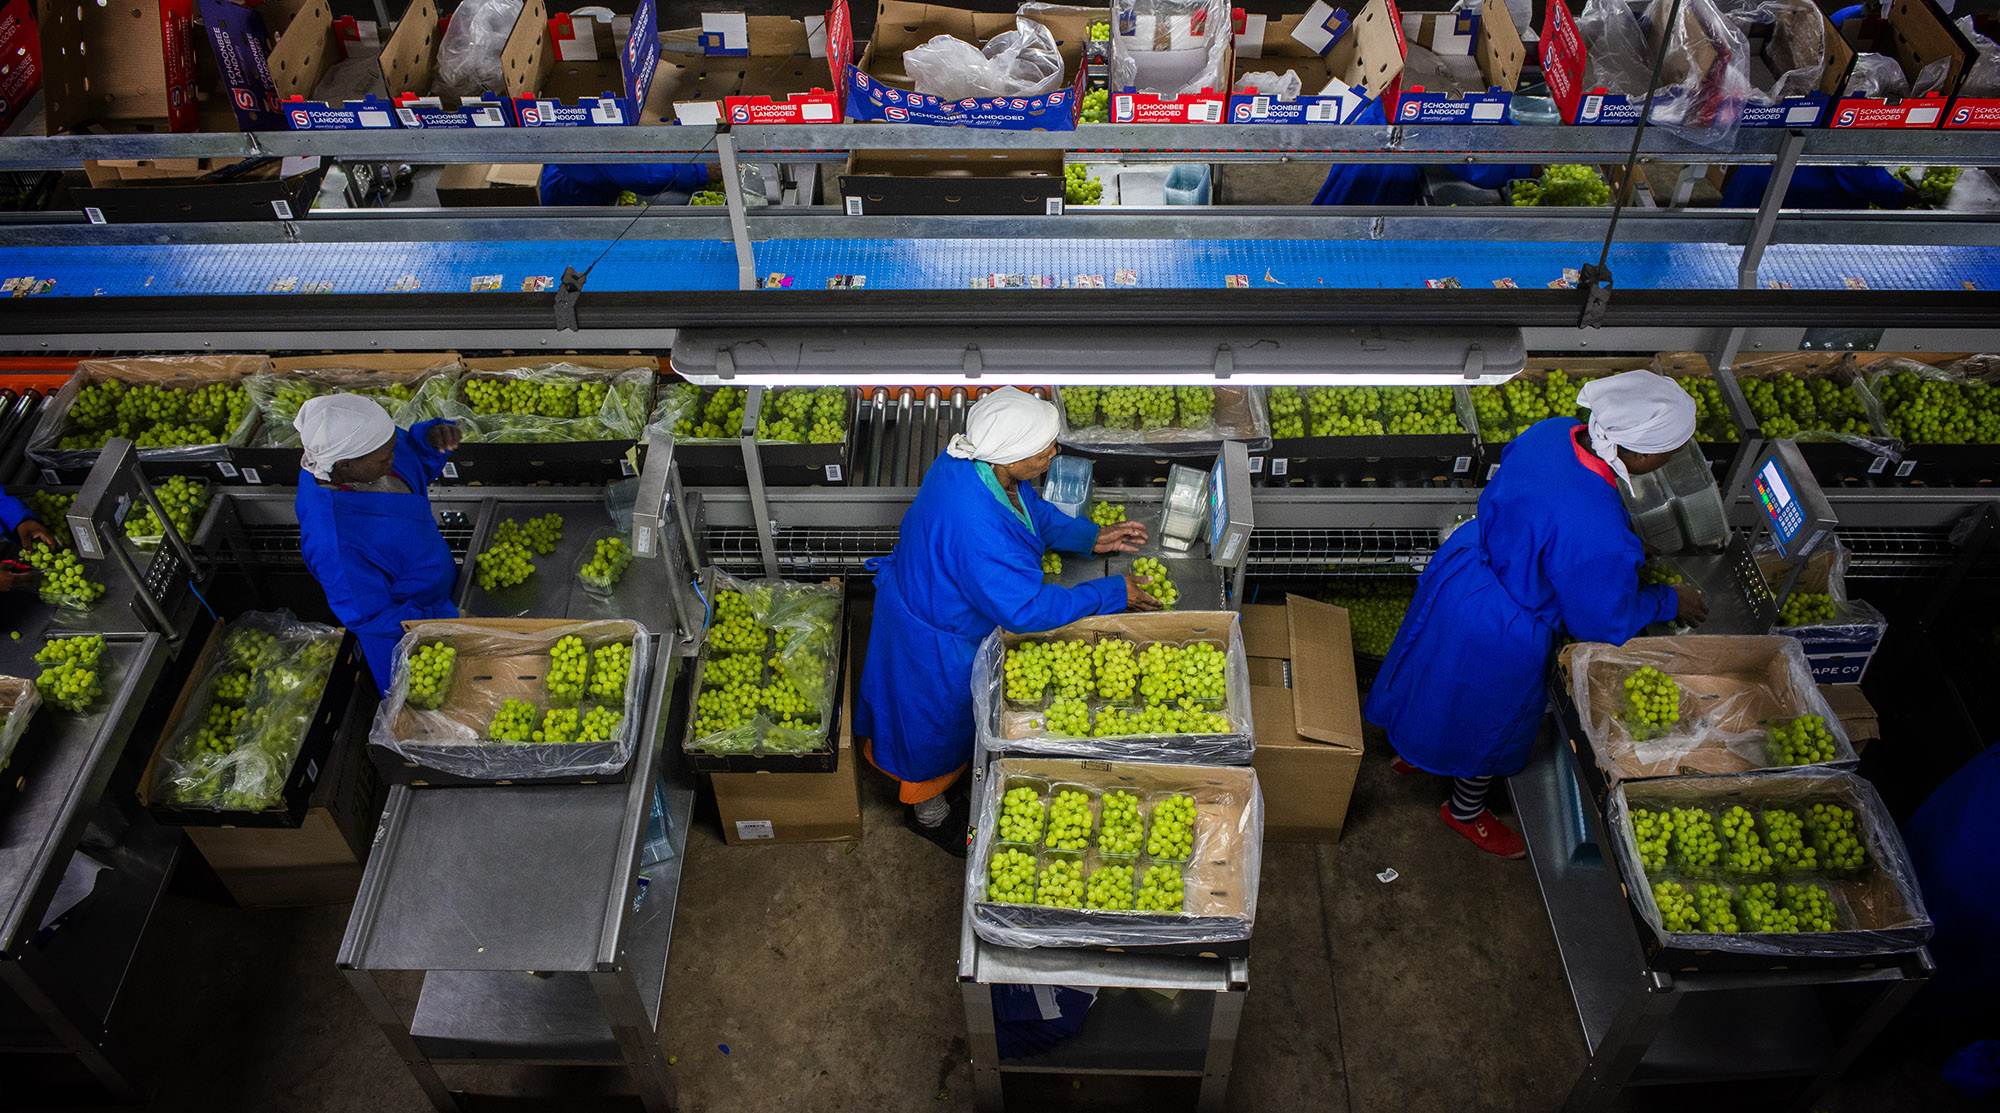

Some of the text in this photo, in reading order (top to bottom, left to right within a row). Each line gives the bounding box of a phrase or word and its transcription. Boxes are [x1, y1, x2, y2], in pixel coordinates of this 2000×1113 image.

[2, 54, 33, 91] SCHOONBEE
[212, 27, 238, 86] SCHOONBEE
[222, 32, 244, 84] LANDGOED
[8, 64, 35, 97] LANDGOED
[910, 111, 968, 120] SCHOONBEE
